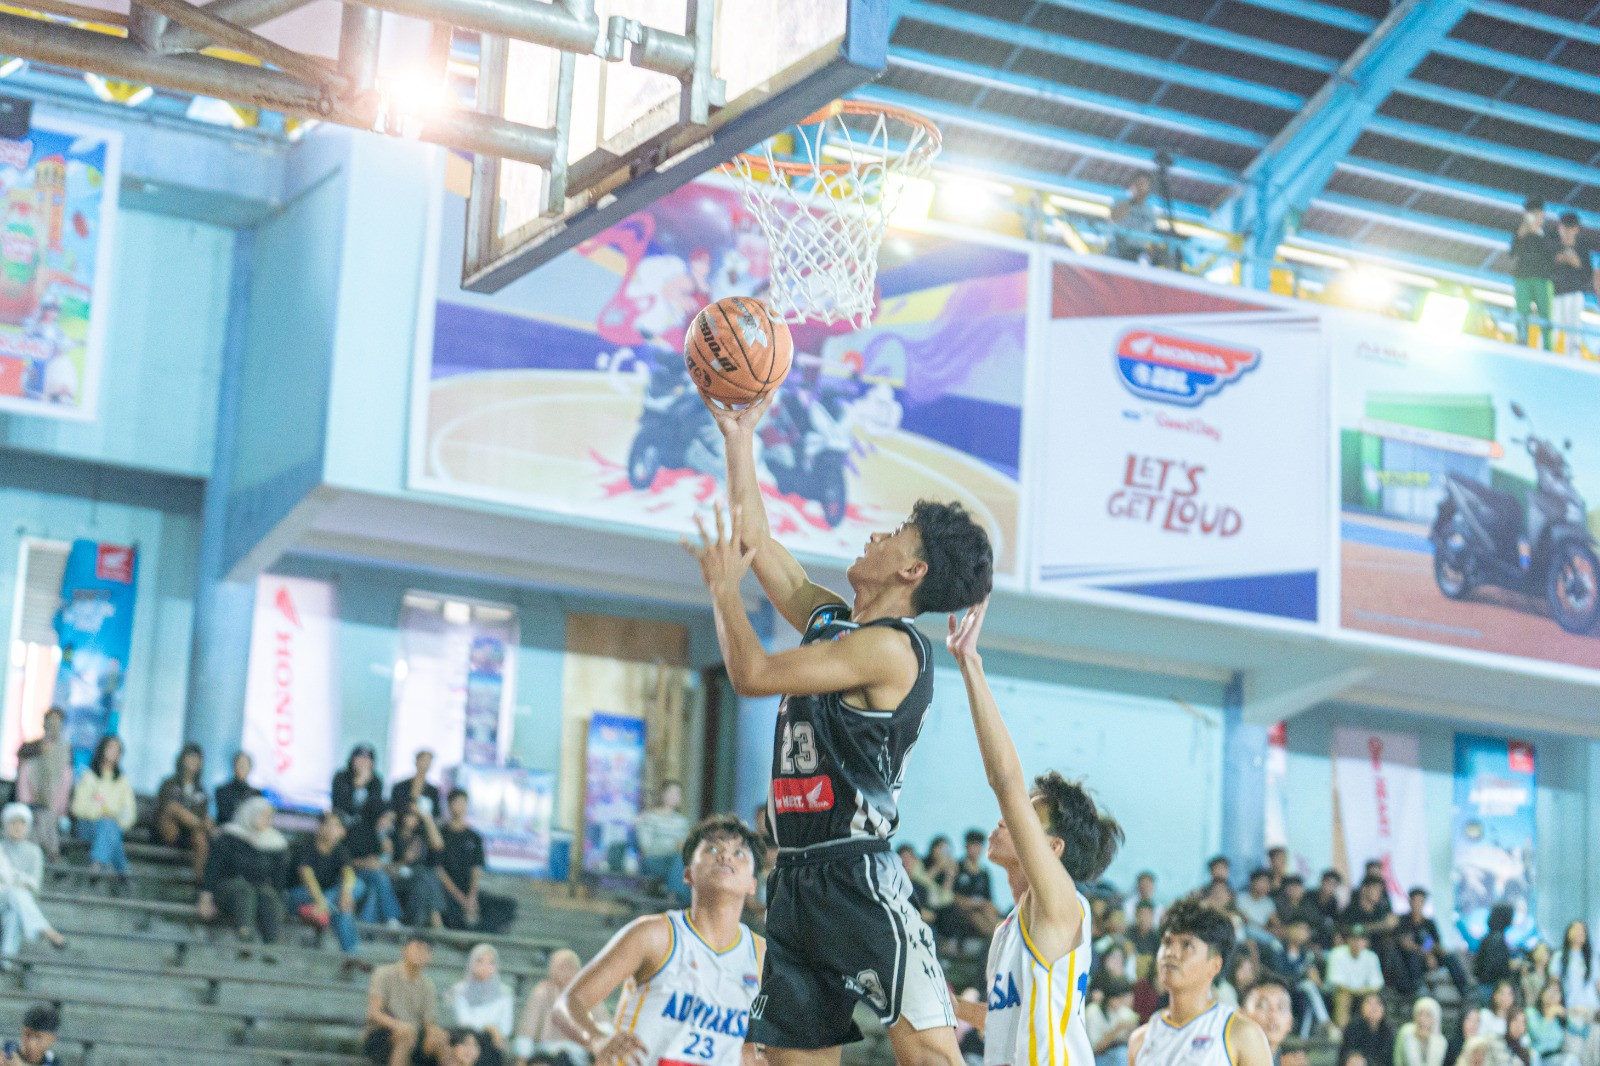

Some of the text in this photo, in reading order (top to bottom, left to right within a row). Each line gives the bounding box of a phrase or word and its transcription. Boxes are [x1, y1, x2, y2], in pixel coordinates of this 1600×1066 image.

[1125, 454, 1205, 496] LET'S
[1108, 491, 1242, 537] GET LOUD
[275, 632, 293, 774] HONDA
[780, 720, 819, 775] 23
[683, 1032, 715, 1059] 23
